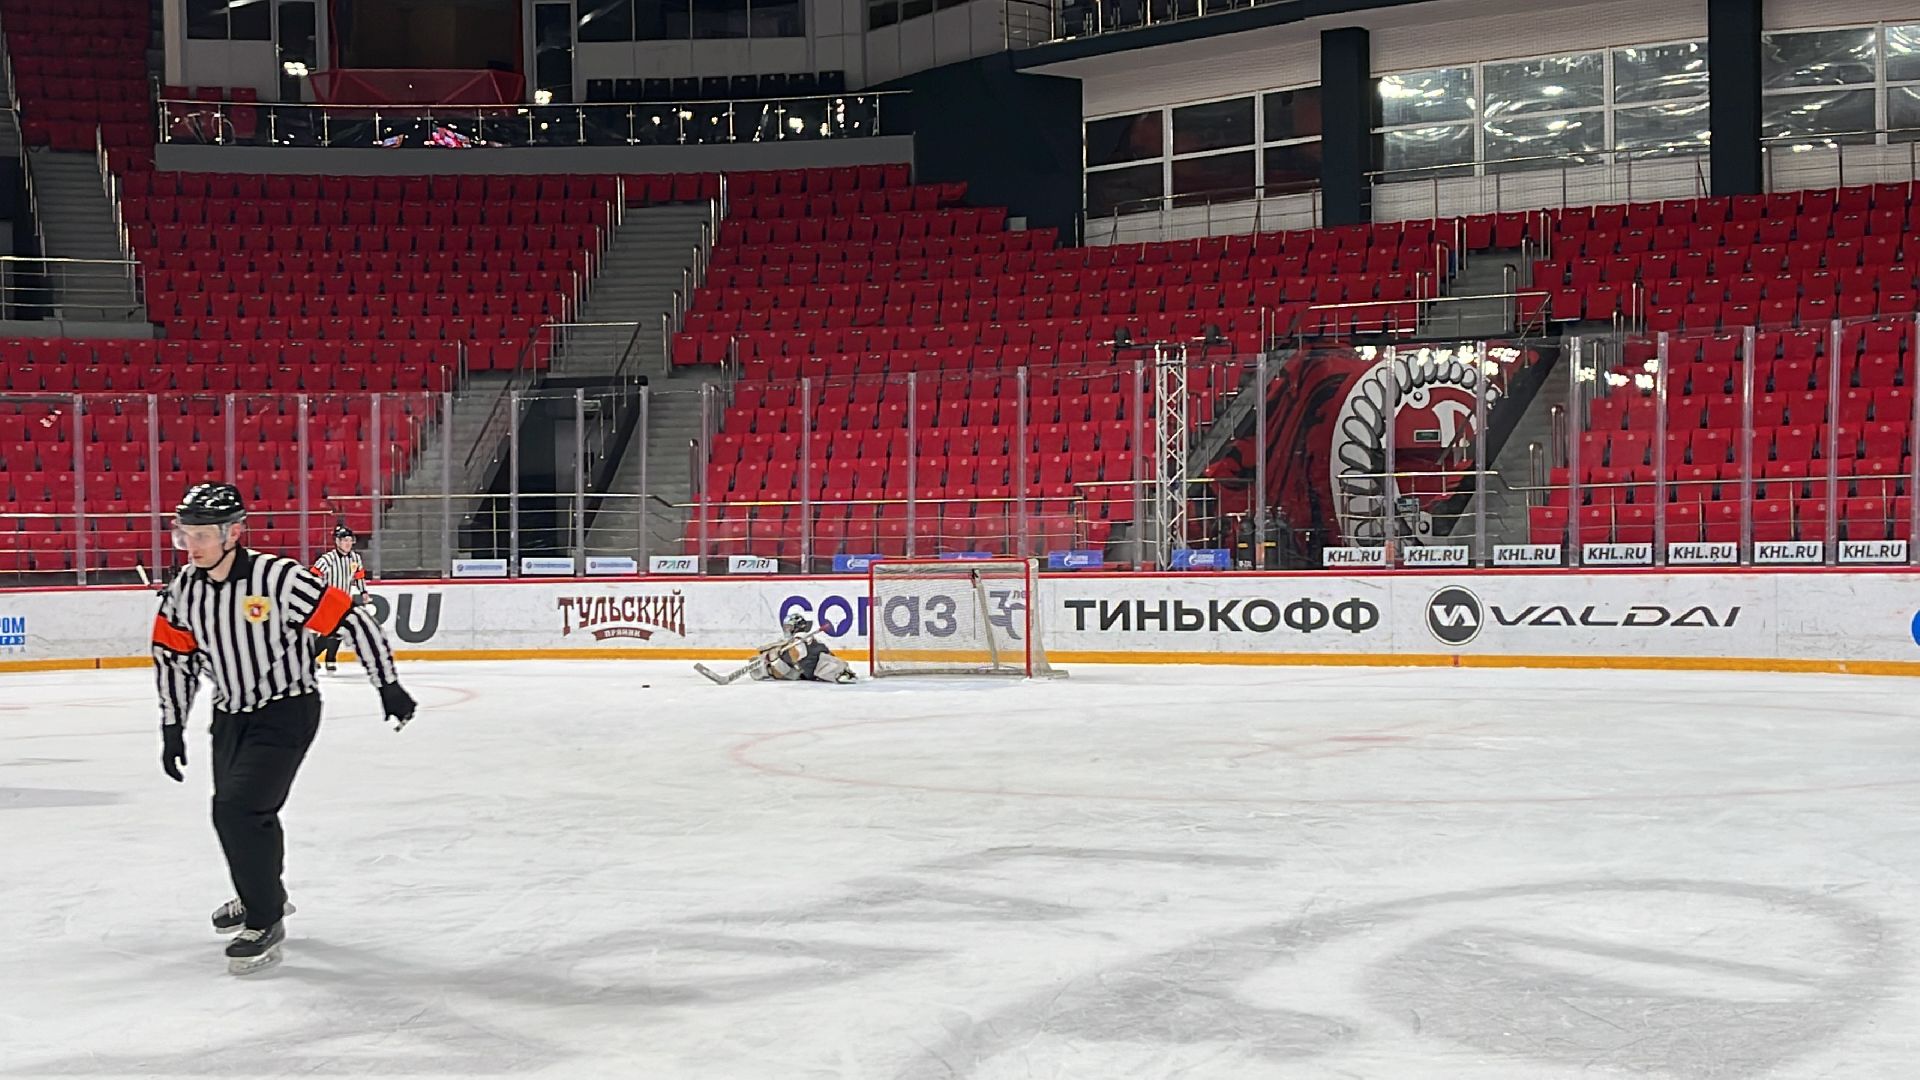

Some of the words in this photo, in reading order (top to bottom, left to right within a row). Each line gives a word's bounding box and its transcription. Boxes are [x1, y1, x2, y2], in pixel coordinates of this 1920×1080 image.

[1327, 549, 1382, 563] KHL.RU
[1407, 548, 1465, 562] KHL.RU
[1497, 547, 1556, 561] KHL.RU
[1587, 546, 1647, 561] KHL.RU
[1673, 545, 1733, 560] KHL.RU
[1758, 544, 1818, 559] KHL.RU
[1843, 543, 1902, 558] KHL.RU
[557, 589, 686, 637] ТУЛЬСКИЙ
[1064, 597, 1380, 633] ТИНЬКОФФ
[1490, 606, 1741, 627] VALDAI
[0, 617, 25, 634] ОМ
